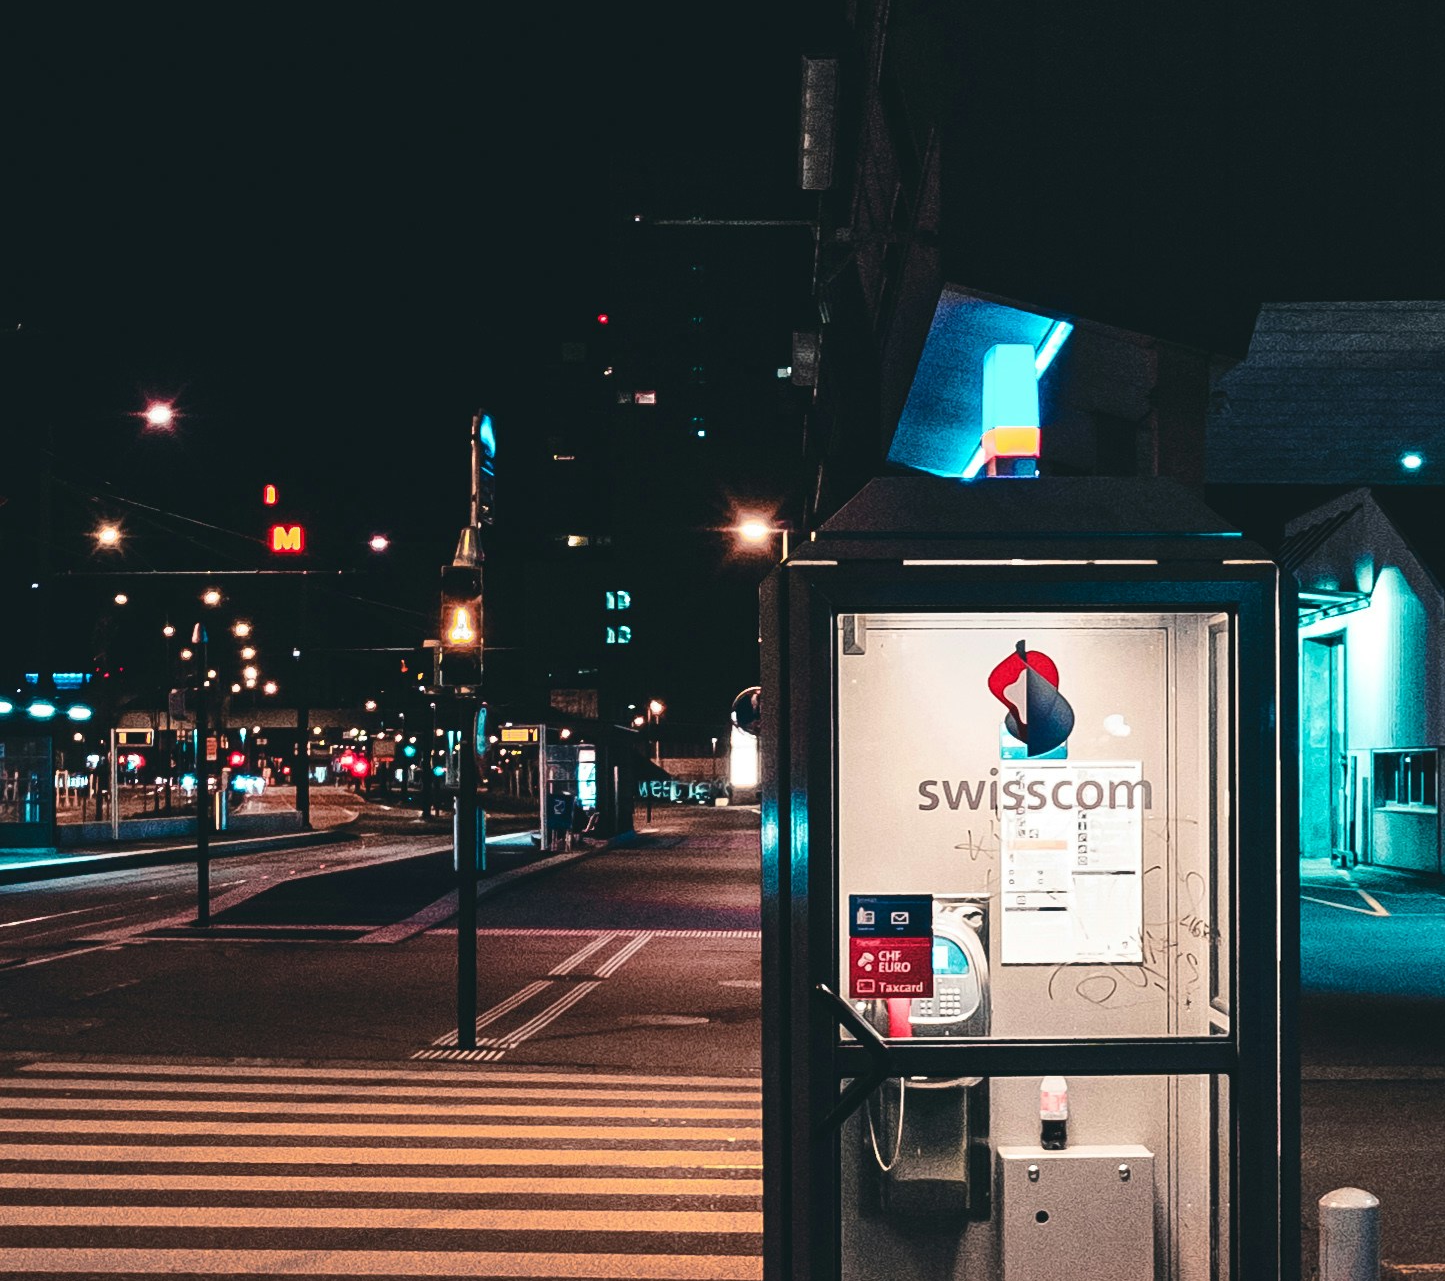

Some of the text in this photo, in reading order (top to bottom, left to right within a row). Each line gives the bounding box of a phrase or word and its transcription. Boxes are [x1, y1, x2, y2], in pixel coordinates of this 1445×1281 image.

[272, 525, 302, 552] M
[918, 767, 1153, 811] swisscom
[878, 950, 902, 962] CHF
[878, 962, 911, 973] EURO
[878, 981, 924, 993] Taxcard
